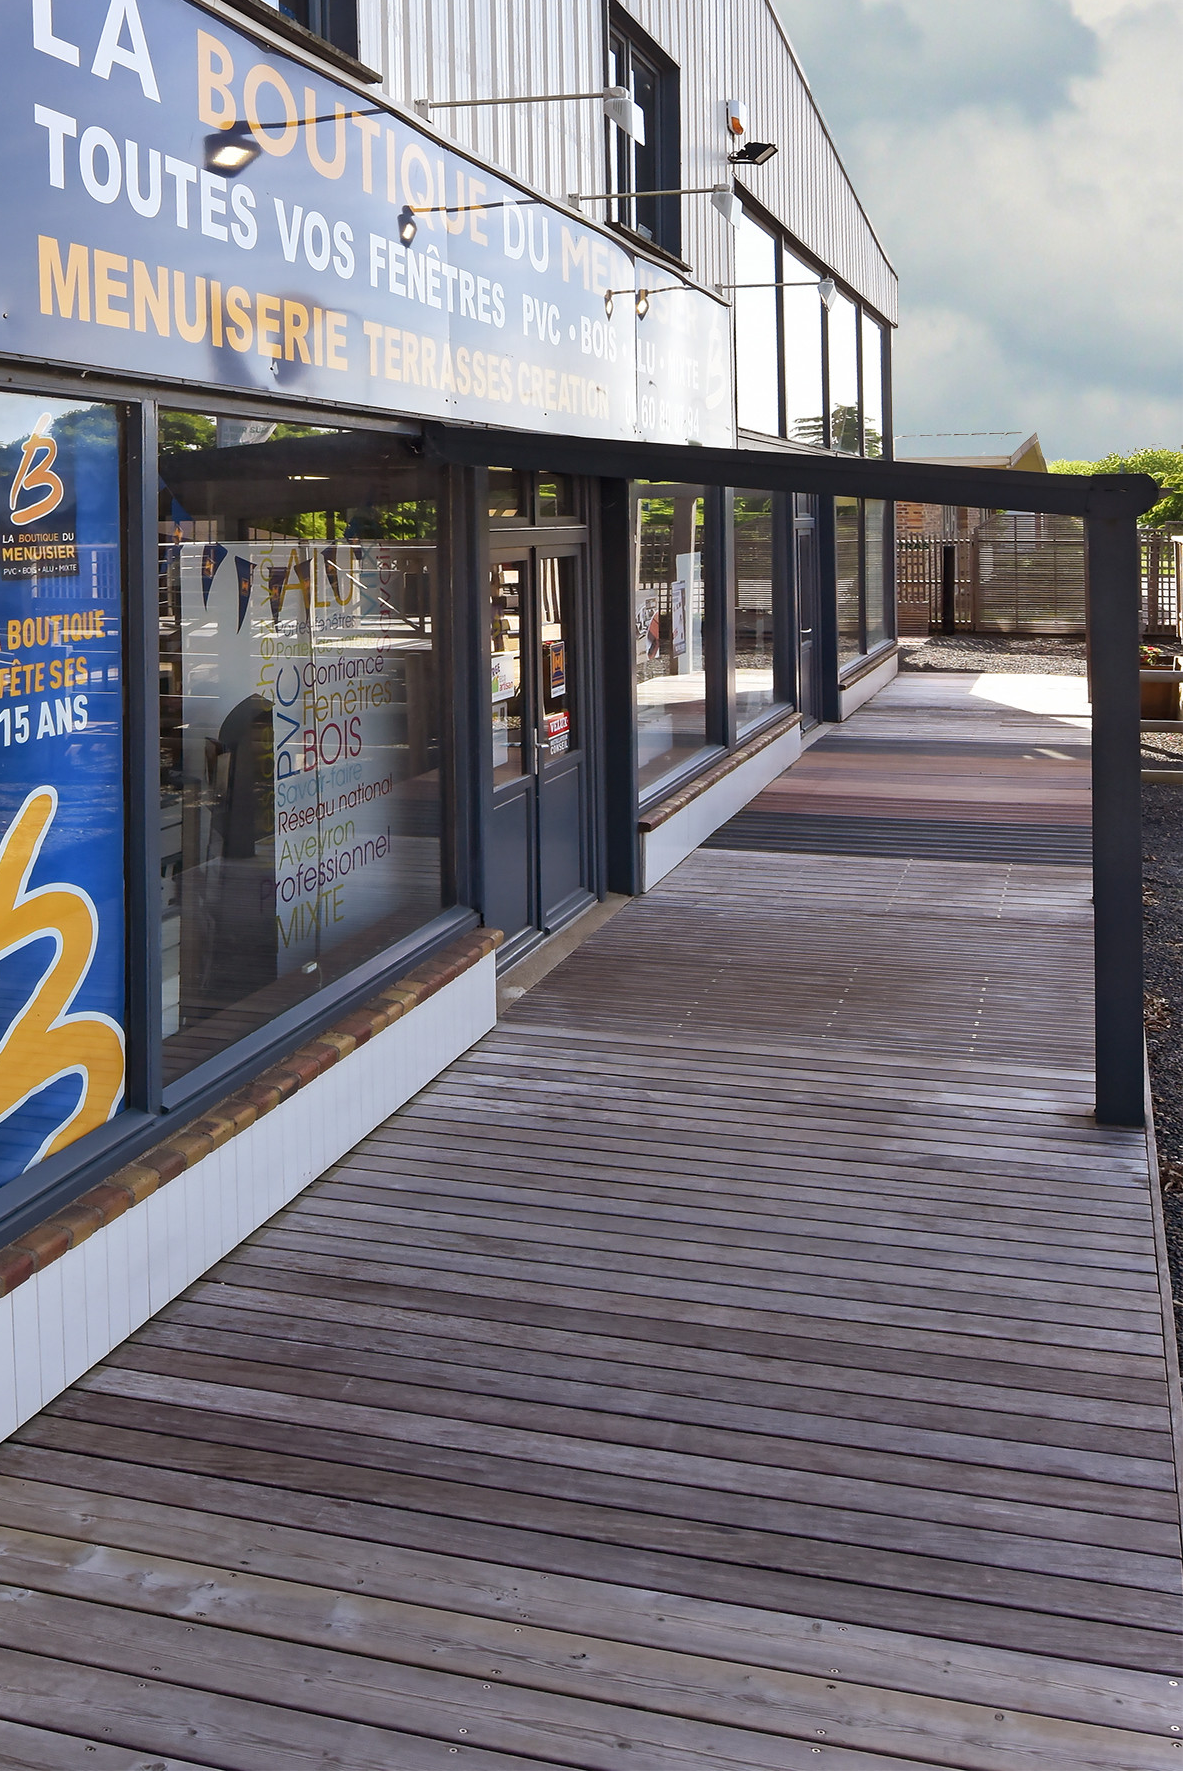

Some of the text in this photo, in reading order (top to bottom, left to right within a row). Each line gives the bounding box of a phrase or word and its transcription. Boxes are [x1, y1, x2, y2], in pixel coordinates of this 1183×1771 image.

[197, 28, 488, 248] BOUTIQUE
[502, 194, 550, 274] DU
[34, 103, 258, 251] TOUTES
[273, 197, 355, 280] VOS
[369, 233, 506, 329] FENÊTRES
[522, 293, 561, 346] PVC
[580, 315, 619, 364] BOIS
[37, 234, 348, 372] MENUISERIE
[363, 320, 513, 405] TERRASSES
[518, 361, 610, 420] CREATION
[2, 532, 75, 544] LA BOUTIQUE DU
[2, 545, 76, 562] MENUISIER
[3, 564, 77, 576] PVC BOIS ALU MIXTE
[278, 546, 355, 614] ALU
[7, 609, 106, 651] BOUTIQUE
[49, 656, 88, 690] SES
[303, 655, 385, 689] Confiance
[0, 694, 89, 747] 15 ANS
[276, 665, 301, 781] PVC
[303, 680, 393, 726] Fenêtres
[303, 716, 362, 773] BOIS
[278, 799, 335, 836] Réseau
[338, 773, 393, 813] national
[279, 820, 355, 871] Aveyron
[276, 884, 345, 949] MIXTE
